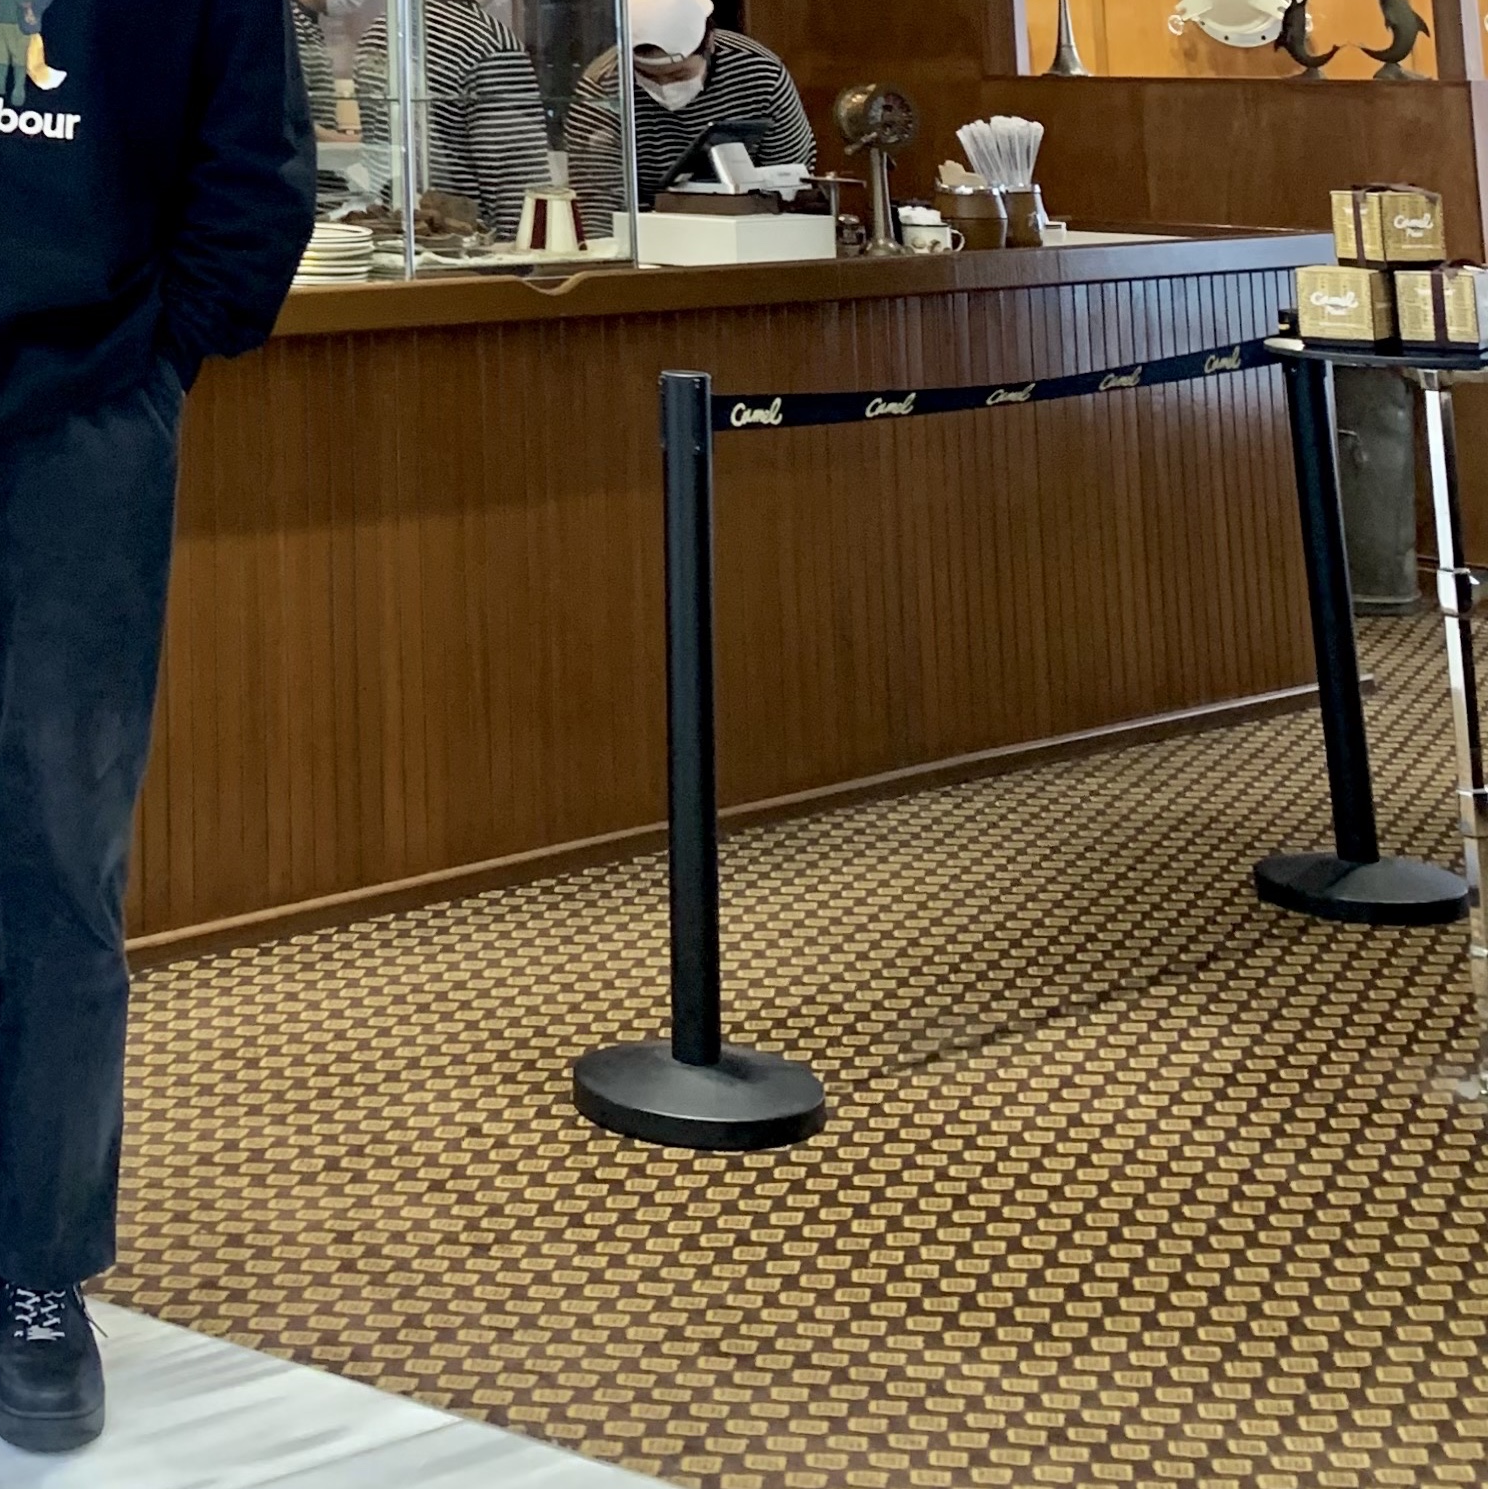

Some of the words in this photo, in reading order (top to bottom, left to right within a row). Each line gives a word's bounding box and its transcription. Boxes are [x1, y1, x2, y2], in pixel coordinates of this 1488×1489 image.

[731, 397, 783, 427] Camel
[865, 392, 916, 418] Camel
[986, 383, 1035, 405] Camel
